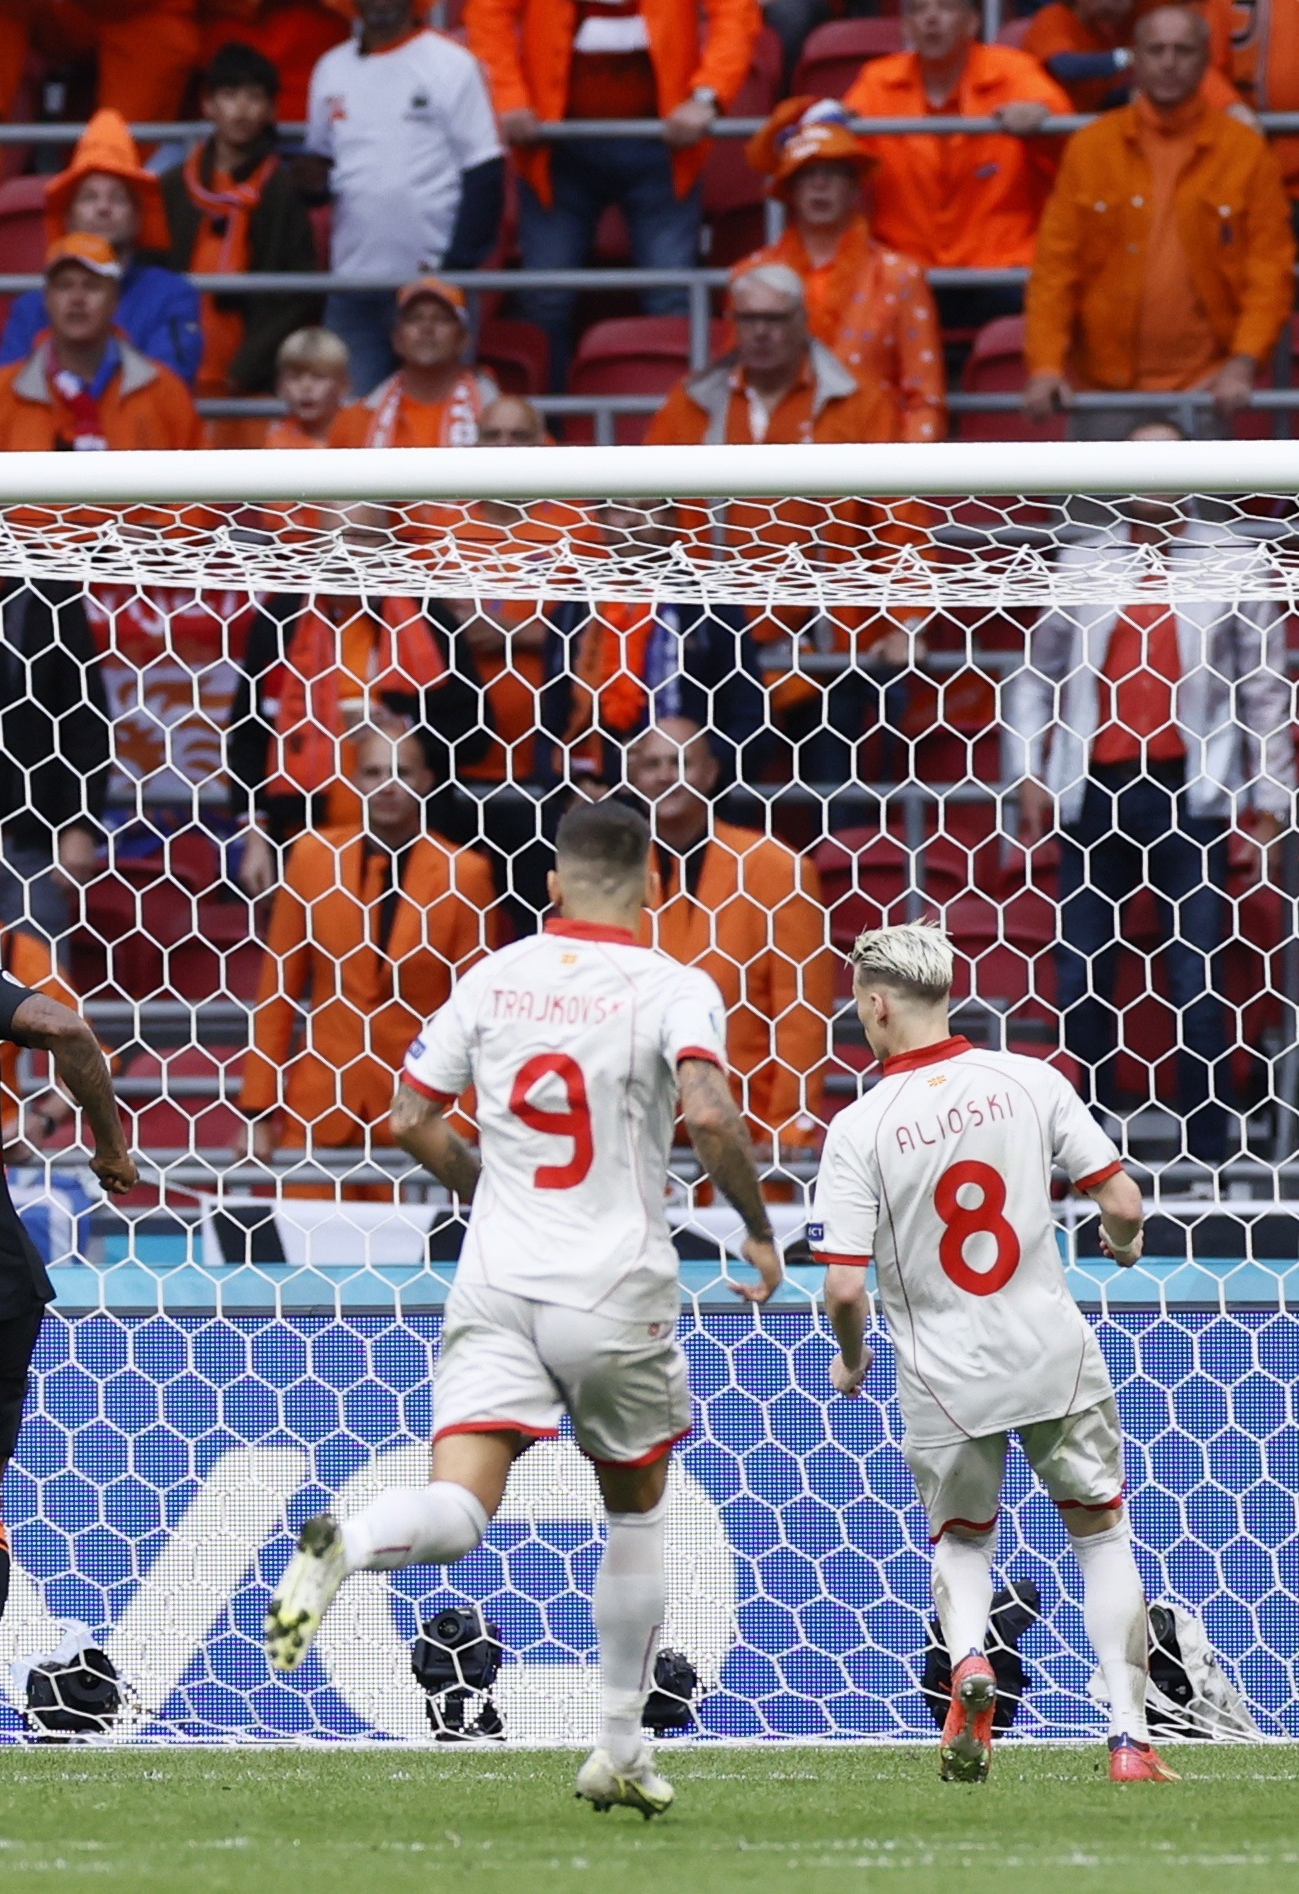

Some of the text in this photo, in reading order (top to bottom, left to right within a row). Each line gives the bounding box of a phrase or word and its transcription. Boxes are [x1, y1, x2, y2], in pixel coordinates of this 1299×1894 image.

[509, 1053, 594, 1189] 9
[895, 1092, 1014, 1154] ALIOSKI
[934, 1160, 1020, 1297] 8
